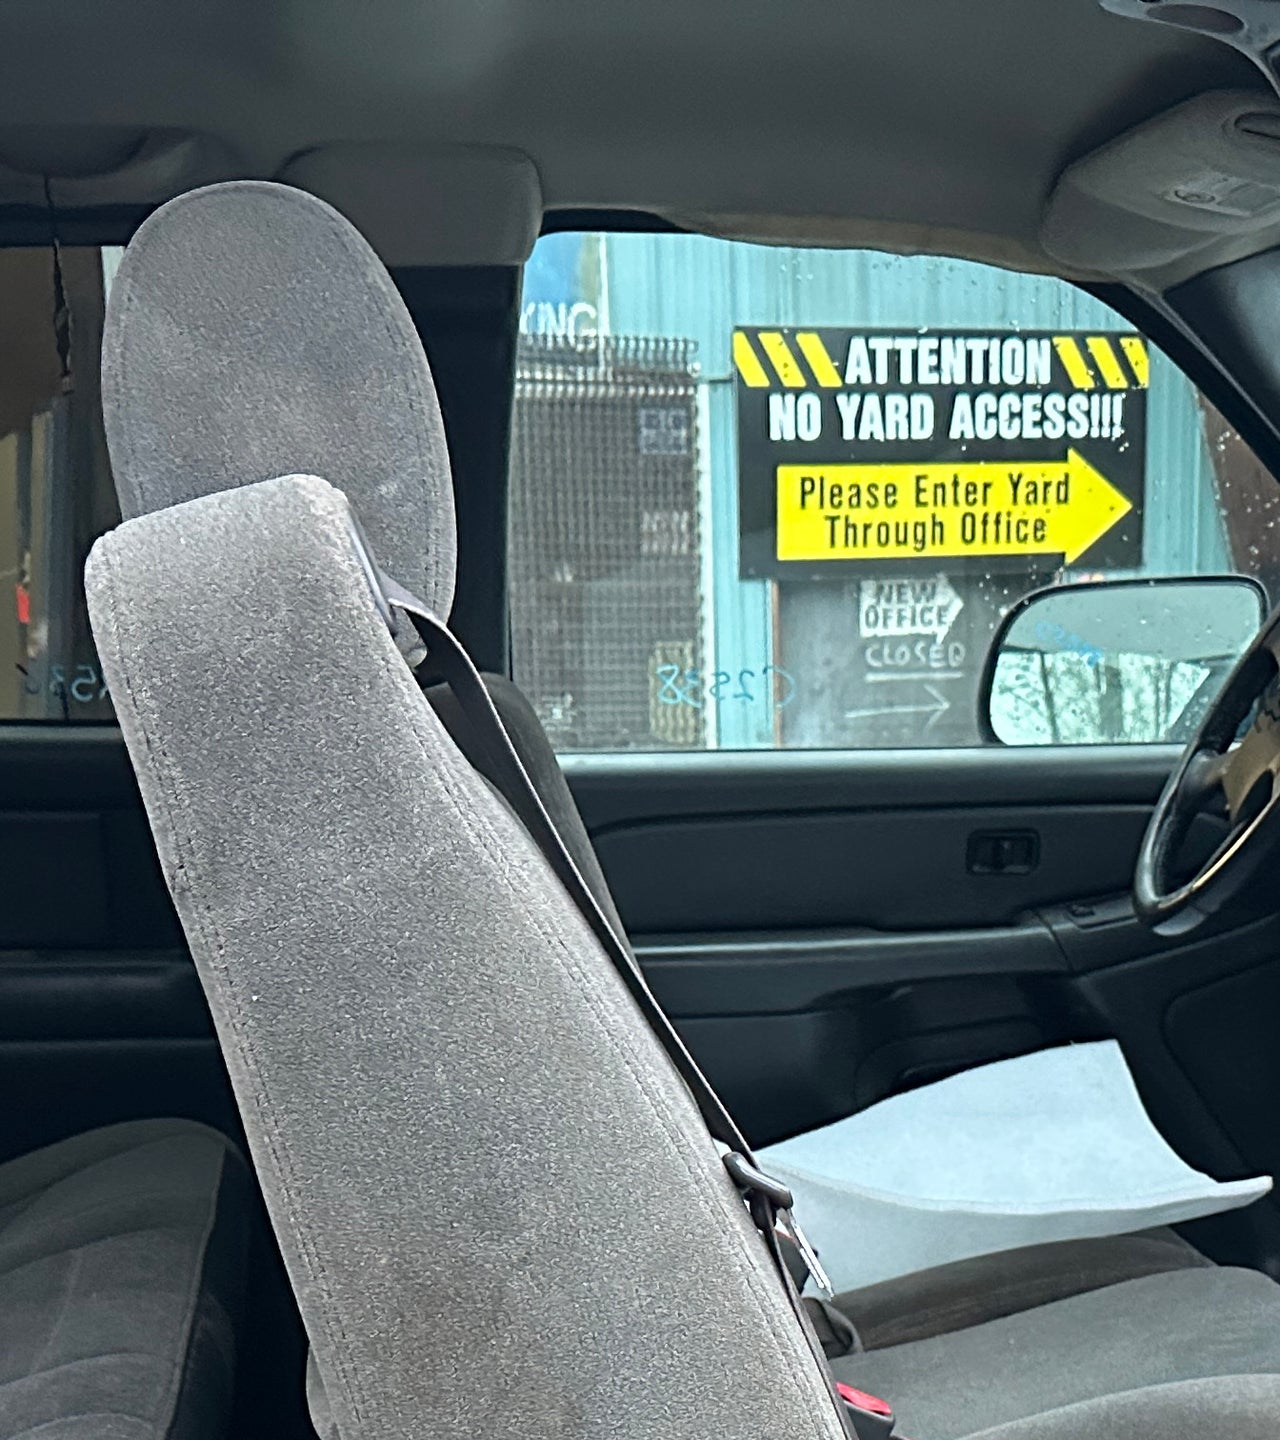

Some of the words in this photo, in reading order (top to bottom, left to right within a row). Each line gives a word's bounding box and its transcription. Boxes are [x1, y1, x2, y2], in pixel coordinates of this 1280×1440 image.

[844, 336, 1051, 385] ATTENTION
[769, 393, 822, 441] NO
[836, 393, 934, 441] YARD
[949, 393, 1123, 441] ACCESS!!!
[800, 475, 898, 510] Please
[915, 474, 992, 508] Enter
[1009, 472, 1070, 506] Yard
[825, 515, 944, 552] Through
[960, 512, 1047, 545] Office
[876, 582, 937, 605] NEW
[864, 604, 950, 629] OFFICE
[864, 640, 966, 669] CLOSED
